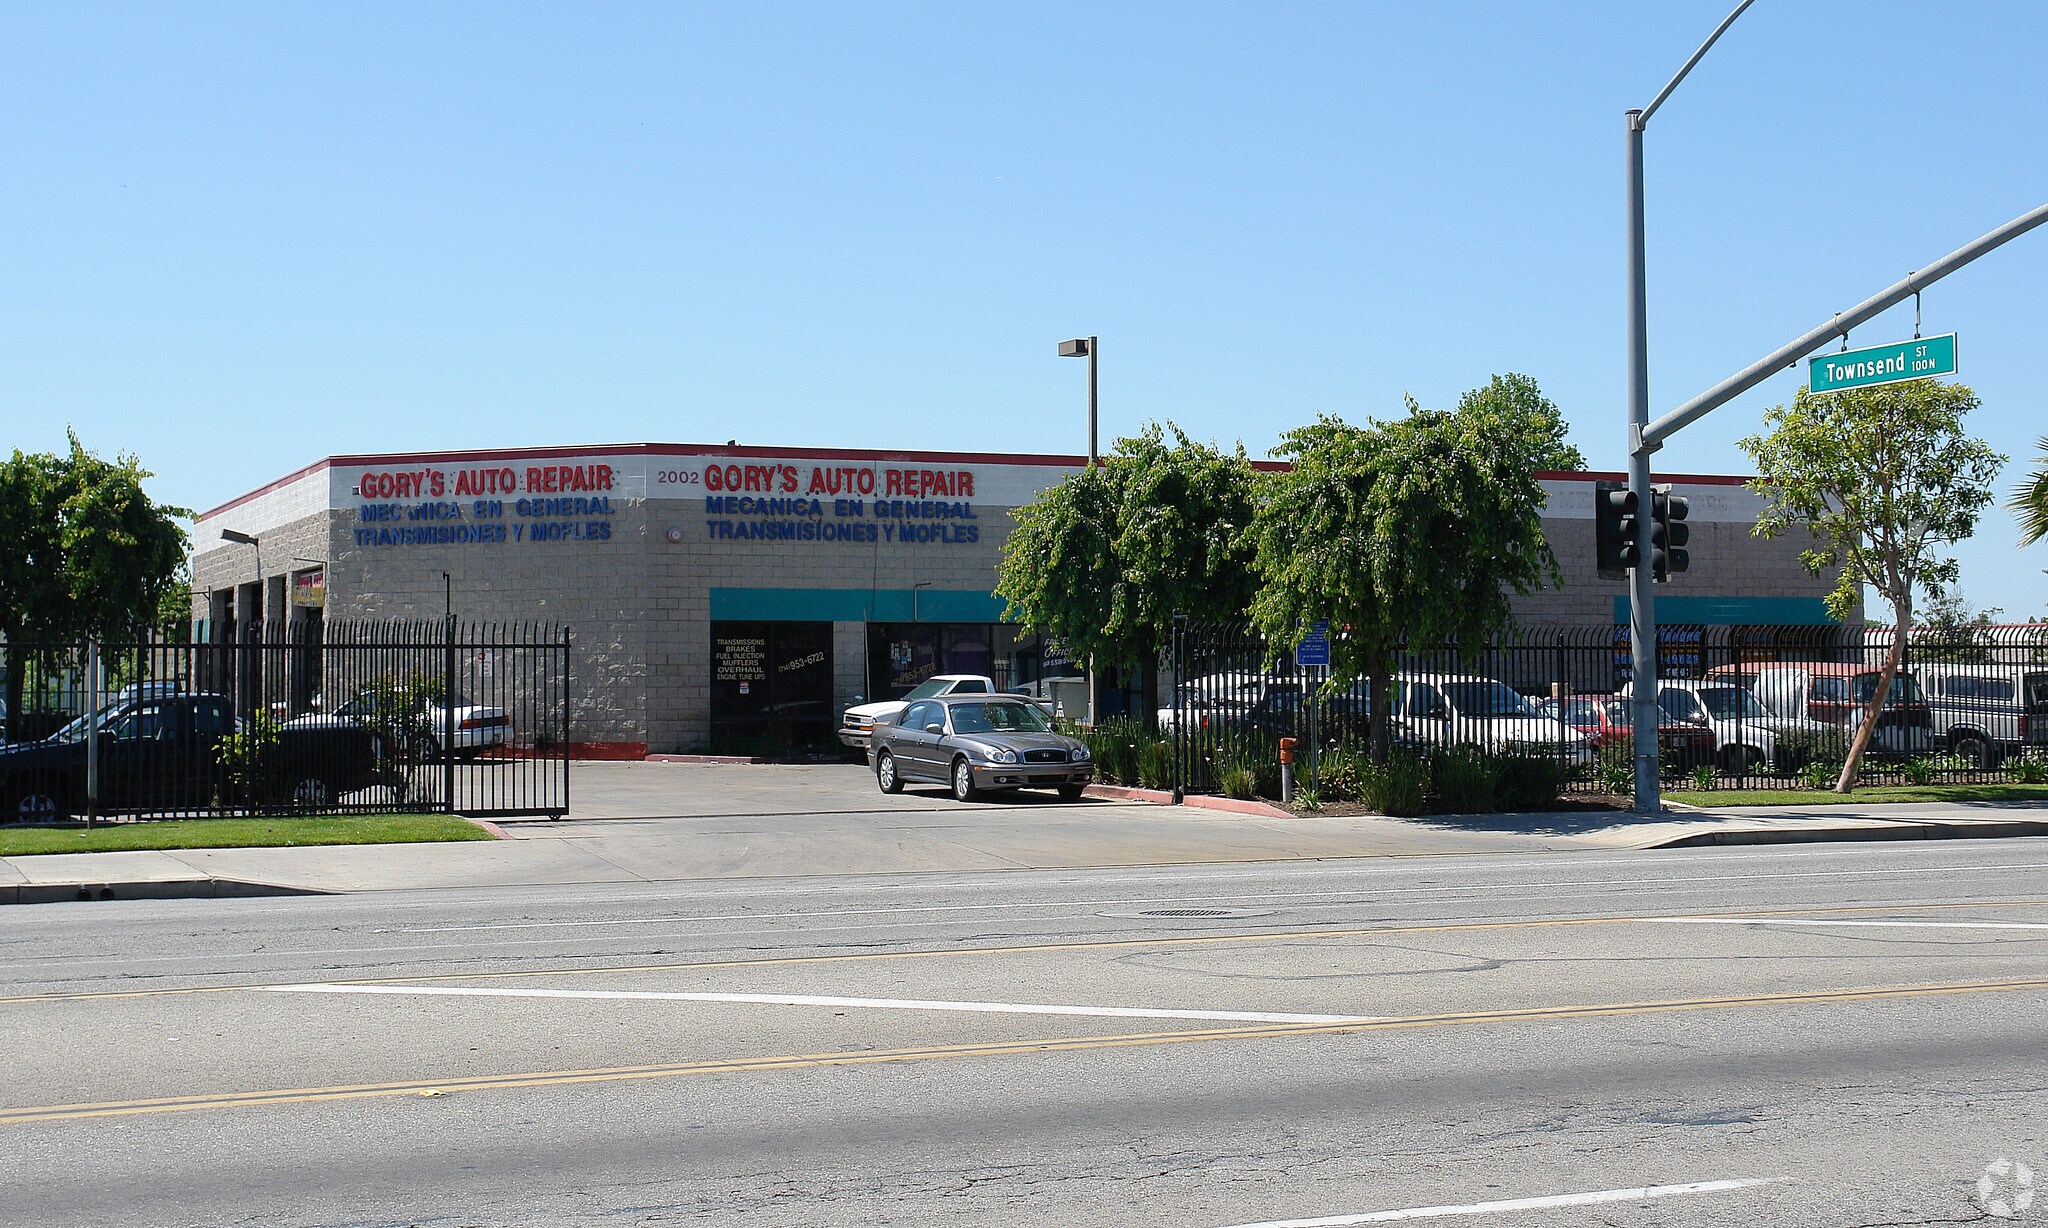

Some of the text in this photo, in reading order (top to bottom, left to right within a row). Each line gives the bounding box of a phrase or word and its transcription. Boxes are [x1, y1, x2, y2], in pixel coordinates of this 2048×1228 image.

[1826, 345, 1928, 383] Townsend ST
[359, 464, 612, 499] GORY'S AUTO REPAIR
[658, 463, 974, 497] 2002 GORY'S AUTO REPAIR
[473, 500, 502, 519] EN
[515, 496, 615, 518] GENERAL
[706, 496, 978, 520] MECANICA EN GENERAL
[353, 520, 612, 547] TRANSMISIONES Y MOFLES
[706, 520, 980, 544] TRANSMISIONES Y MOFLES
[717, 673, 766, 681] ENGINE TUNE UPS
